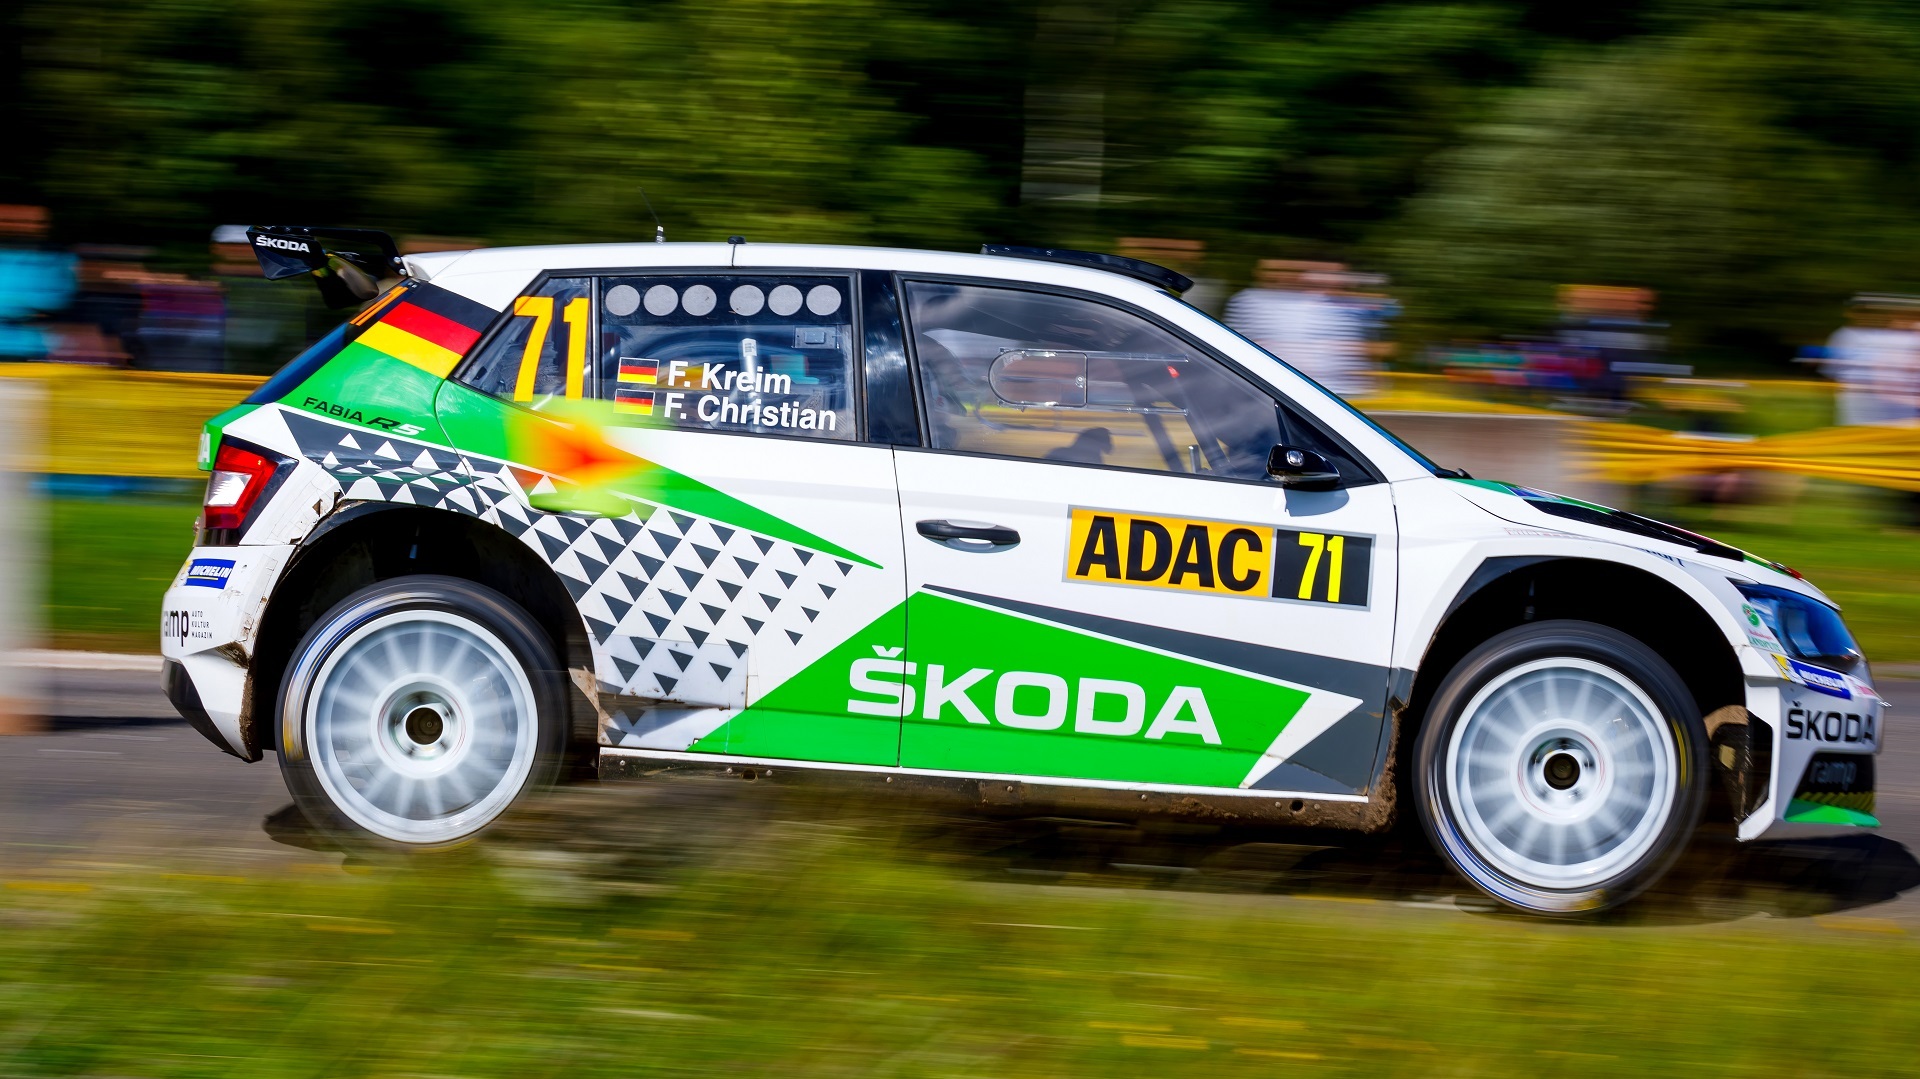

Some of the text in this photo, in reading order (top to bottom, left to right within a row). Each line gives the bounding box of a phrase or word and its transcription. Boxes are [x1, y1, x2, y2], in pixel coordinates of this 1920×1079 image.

[256, 235, 311, 254] ŠKODA
[513, 295, 590, 402] 71
[667, 360, 791, 395] F. Kreim
[302, 397, 426, 436] FABIA R5
[664, 392, 837, 431] F. Christian
[190, 566, 232, 578] MICHELIN
[1075, 515, 1345, 603] ADAC 71
[191, 610, 204, 618] AUTO
[191, 621, 210, 629] KULTUR
[191, 631, 213, 639] MAGAZIN
[847, 644, 1223, 745] ŠKODA
[1785, 700, 1877, 746] ŠKODA
